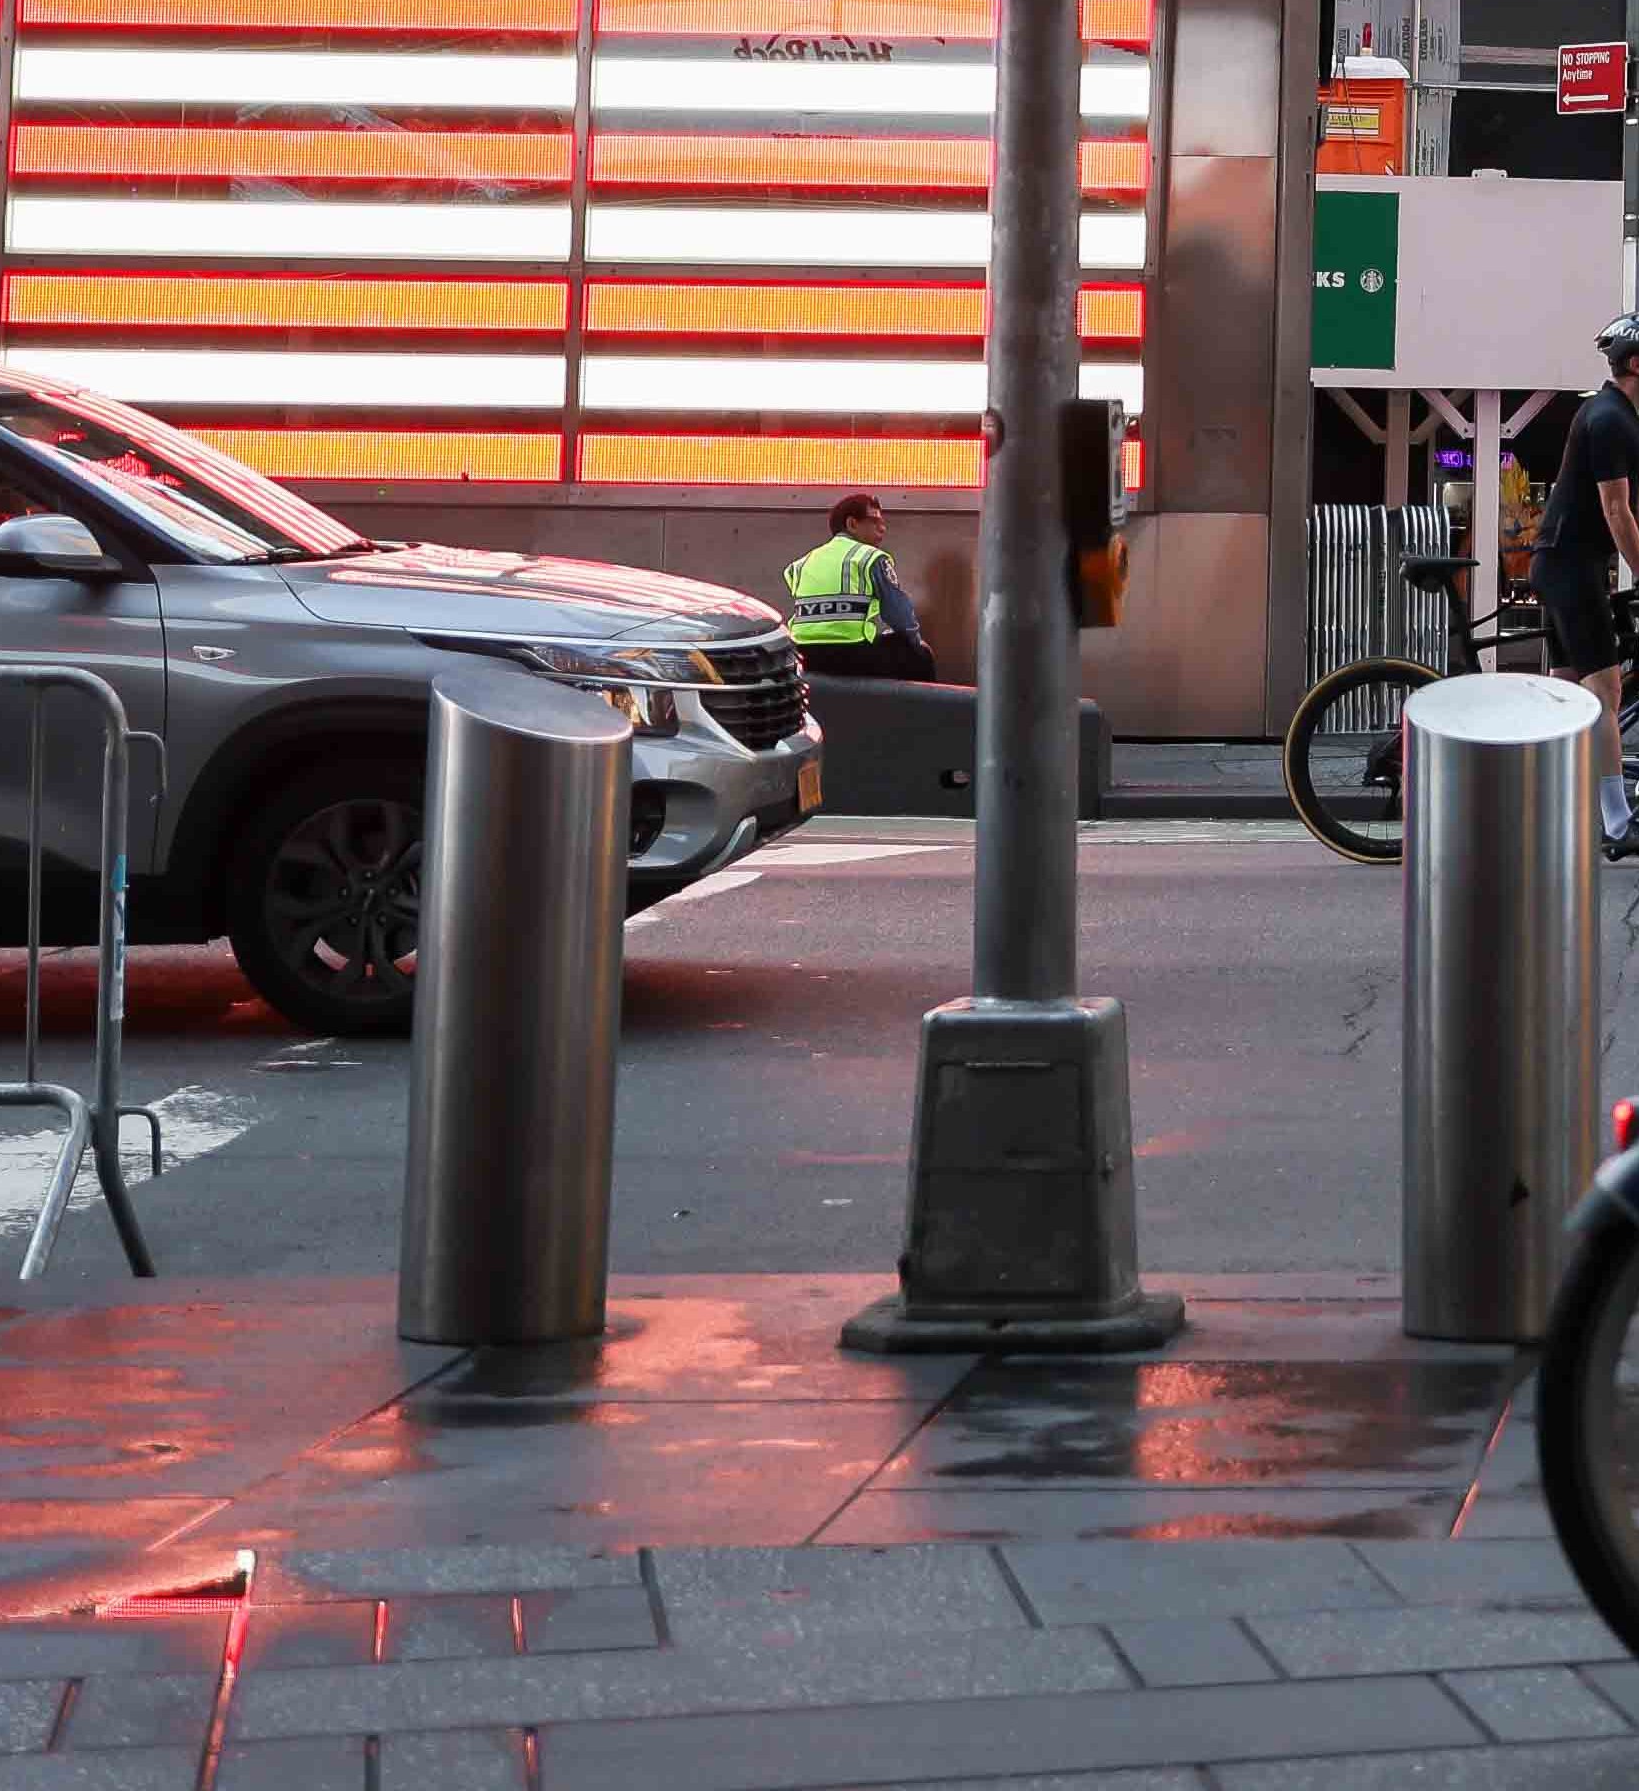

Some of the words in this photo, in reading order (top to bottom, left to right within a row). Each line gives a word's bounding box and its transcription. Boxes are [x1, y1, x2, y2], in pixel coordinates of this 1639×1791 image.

[1562, 53, 1574, 65] NO
[1576, 51, 1610, 64] STOPPING
[1562, 69, 1593, 83] Anytime
